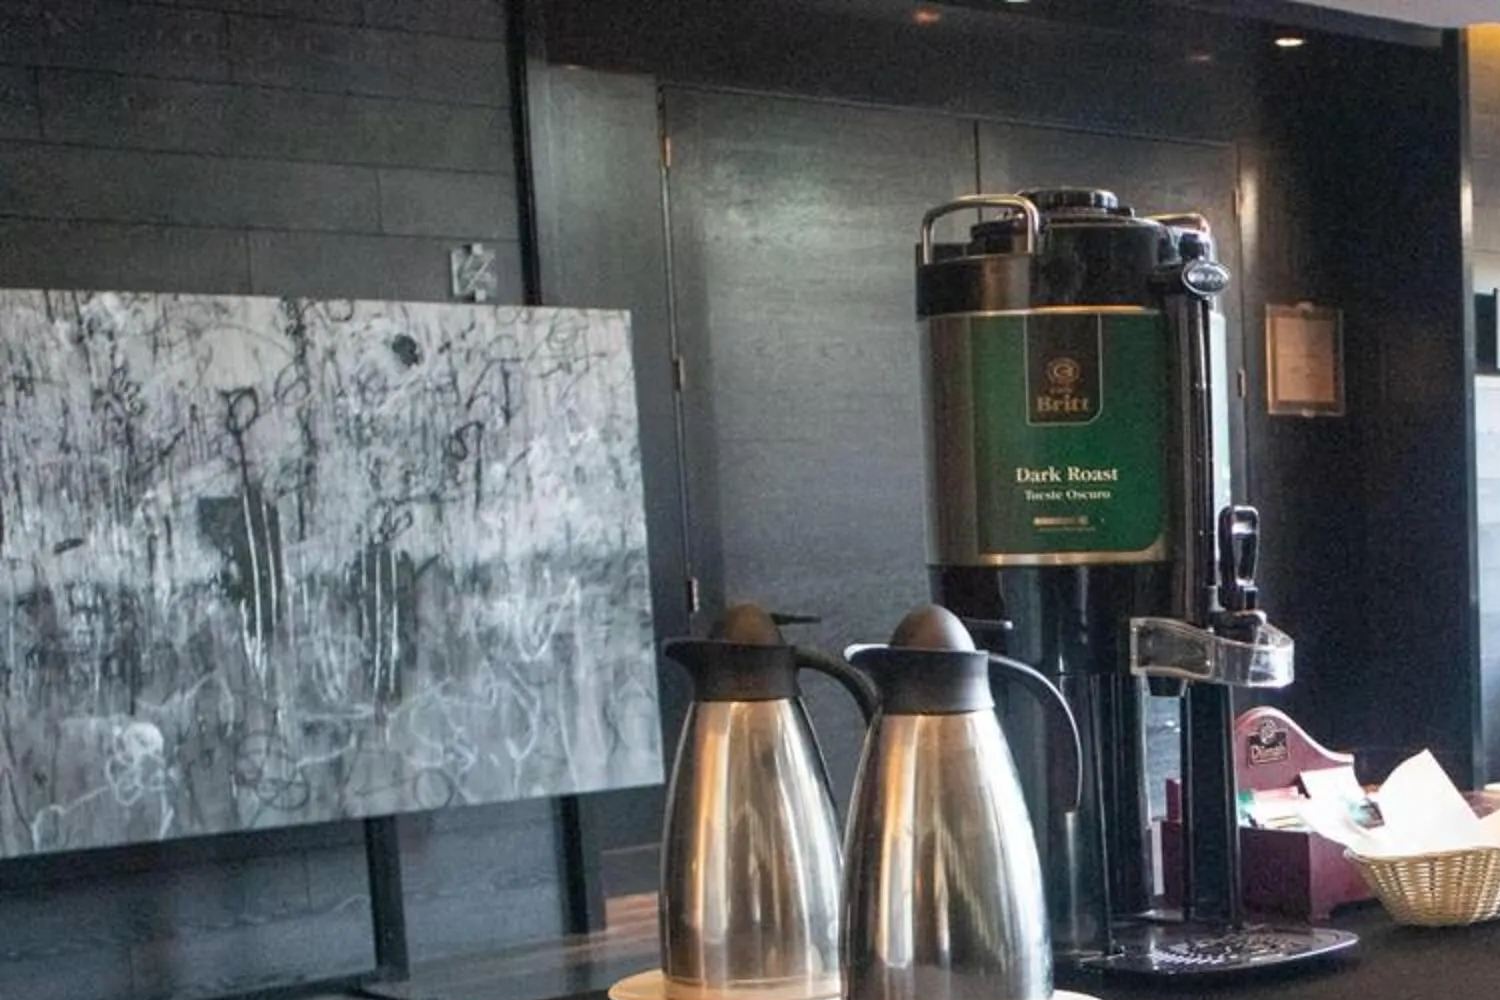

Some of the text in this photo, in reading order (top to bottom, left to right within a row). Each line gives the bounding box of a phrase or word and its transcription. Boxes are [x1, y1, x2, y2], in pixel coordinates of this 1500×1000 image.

[1036, 394, 1089, 413] Britt
[1015, 465, 1119, 482] Dark Roast
[1065, 489, 1111, 500] Oscuro
